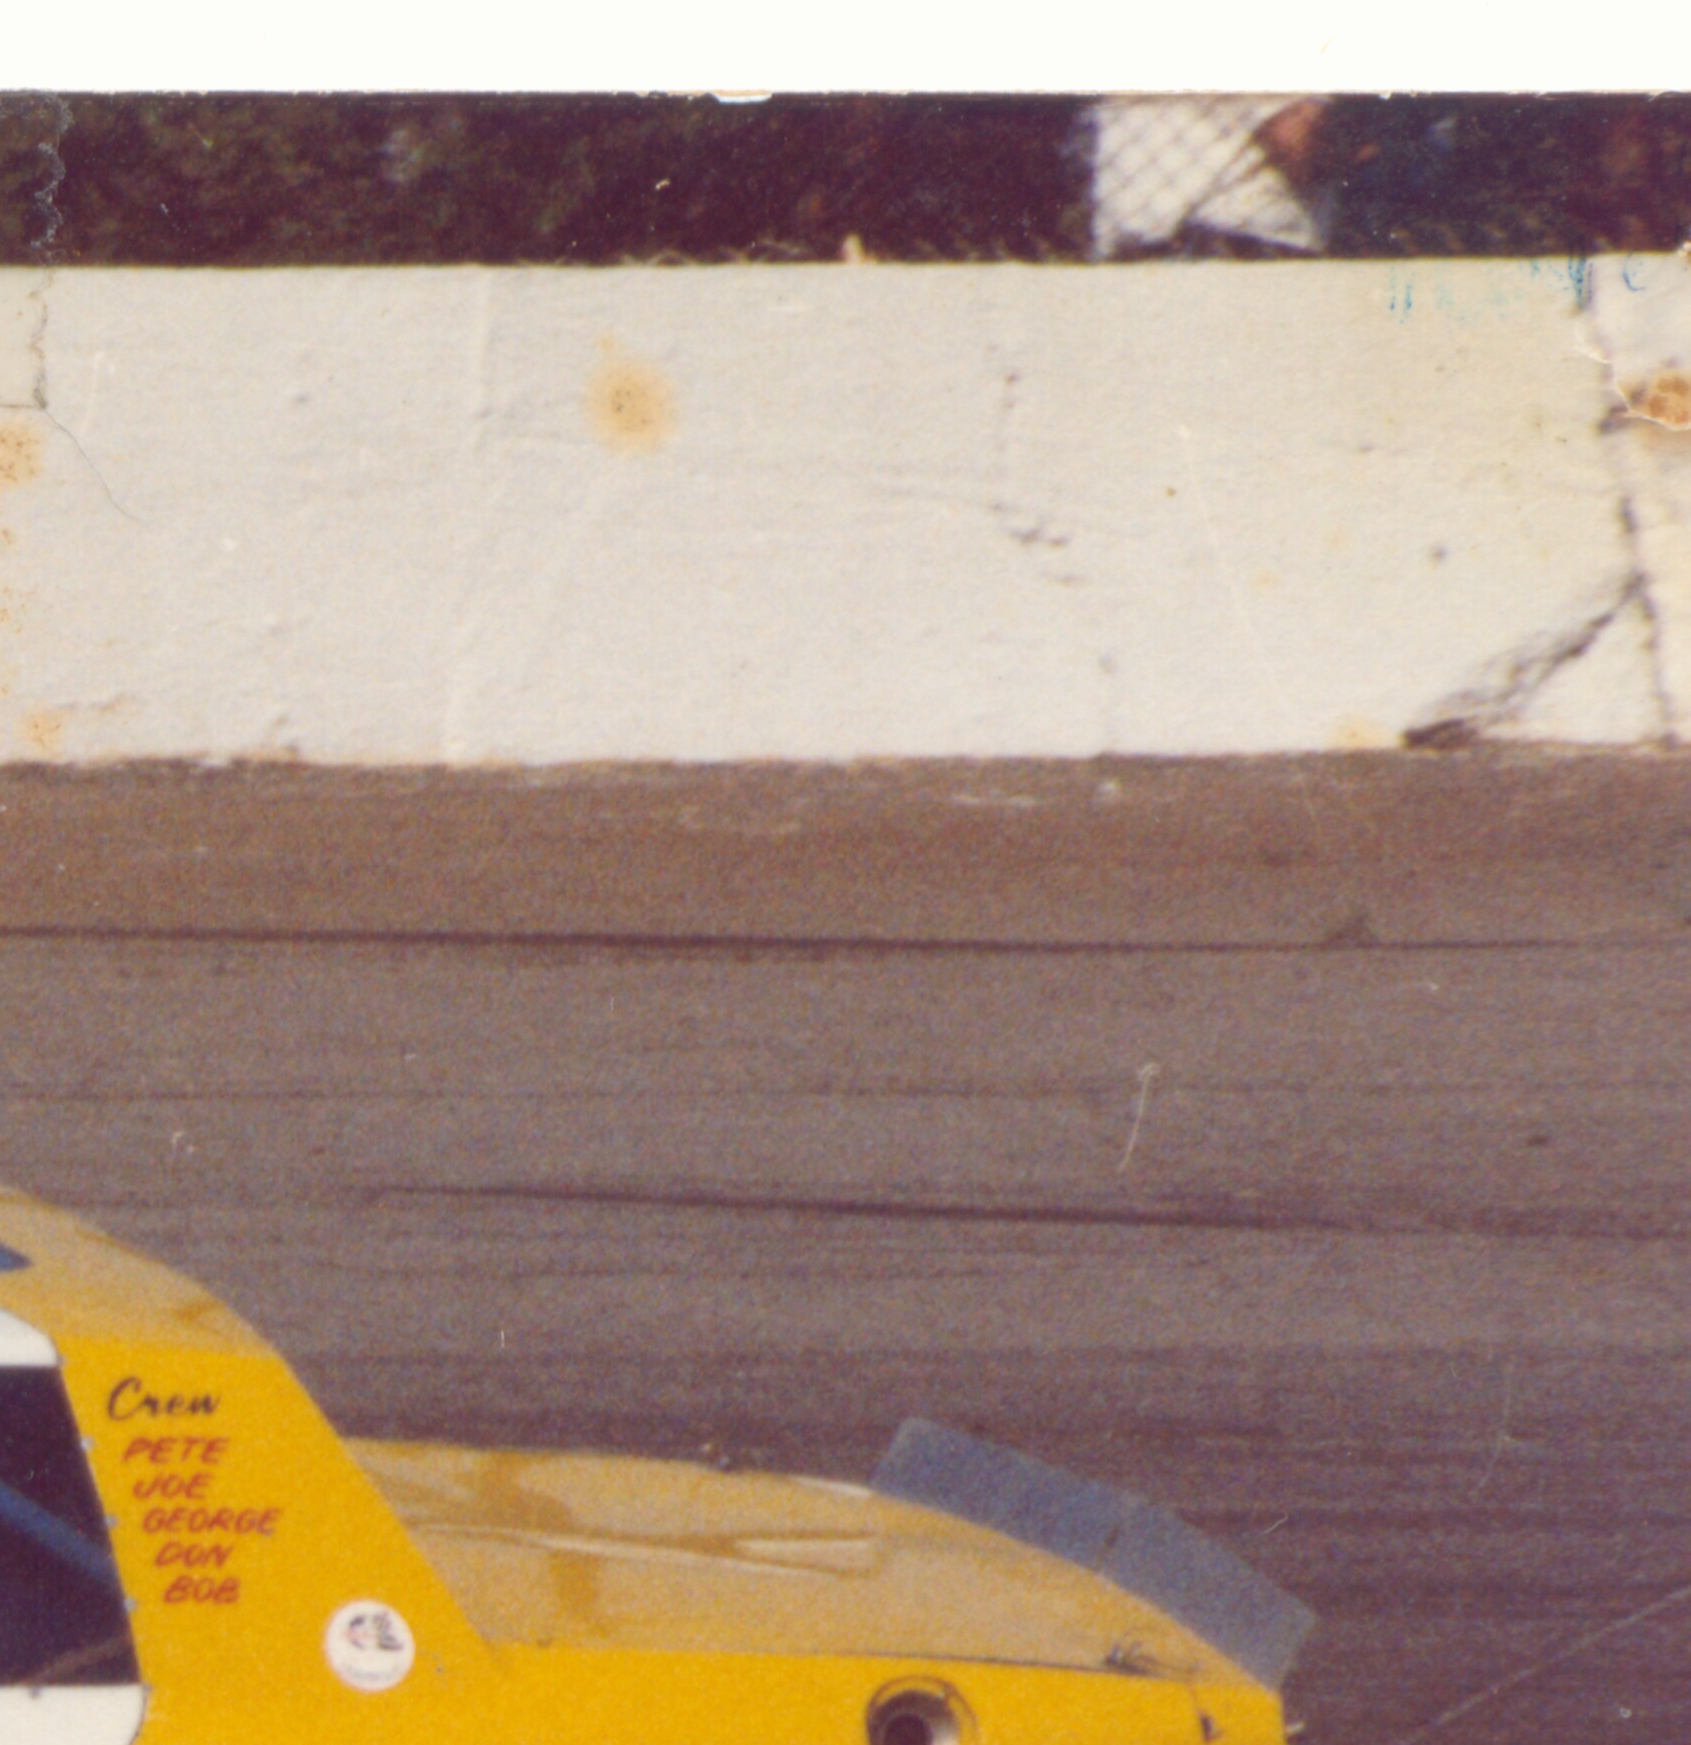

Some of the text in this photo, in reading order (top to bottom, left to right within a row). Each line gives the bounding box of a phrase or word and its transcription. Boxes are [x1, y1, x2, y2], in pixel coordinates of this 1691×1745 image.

[107, 1376, 221, 1421] Crew
[122, 1436, 229, 1465] PETE
[133, 1472, 212, 1499] JOE
[142, 1506, 283, 1535] GEORGE
[154, 1542, 233, 1568] DON
[164, 1575, 241, 1605] BOB
